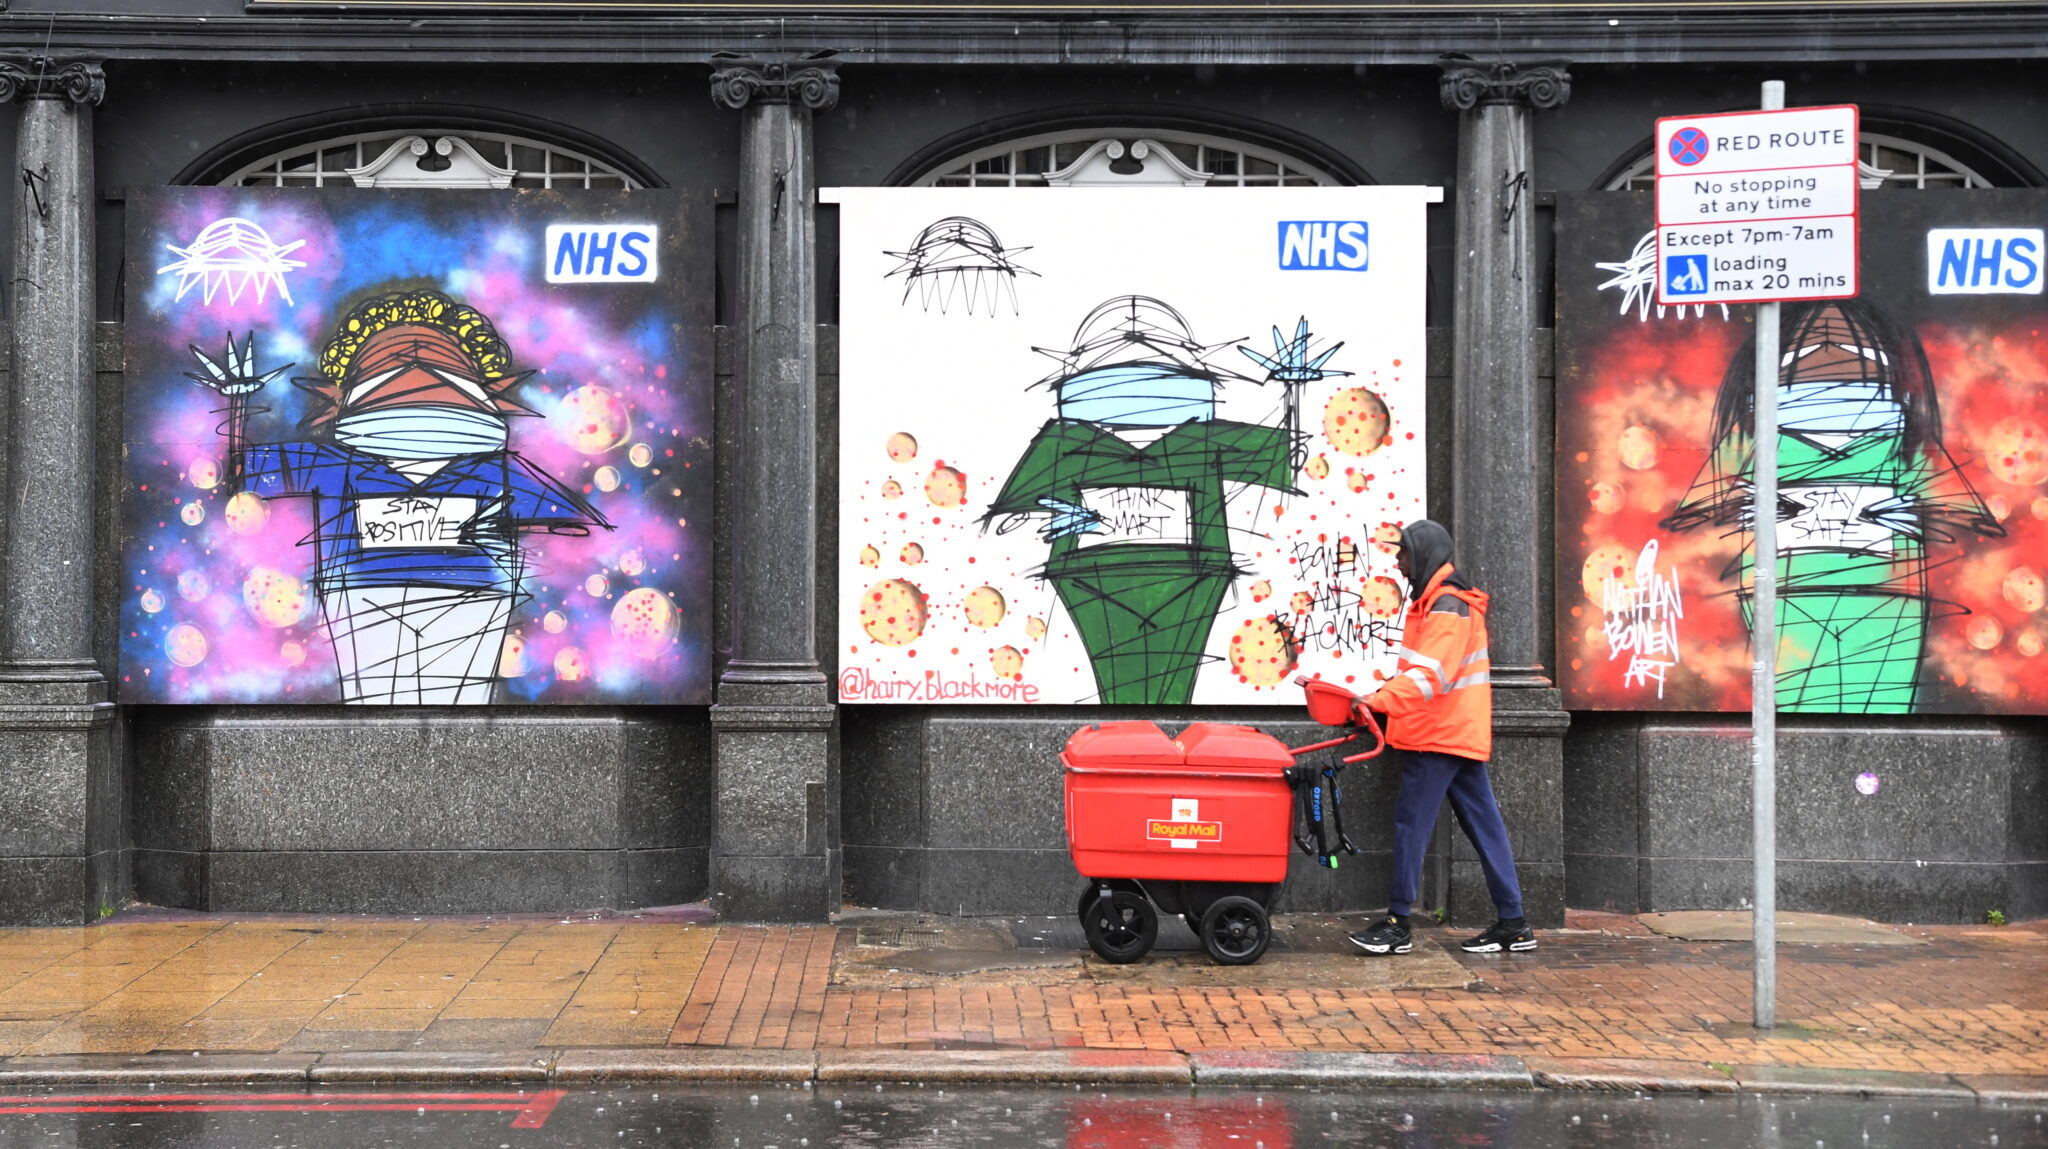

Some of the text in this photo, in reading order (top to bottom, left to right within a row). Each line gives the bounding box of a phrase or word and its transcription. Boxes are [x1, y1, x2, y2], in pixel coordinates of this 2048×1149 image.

[1717, 129, 1844, 151] RED ROUTE
[1694, 176, 1817, 194] No stopping
[1699, 196, 1812, 214] at any time
[1281, 222, 1369, 269] NHS
[1666, 226, 1833, 247] Except 7pm-7am
[553, 231, 651, 277] NHS
[1714, 256, 1787, 271] loading
[1936, 237, 2039, 288] NHS
[1714, 273, 1846, 292] max 20 mins
[382, 497, 443, 524] STAY
[1099, 487, 1175, 511] THINK
[1800, 487, 1862, 517] STAY
[364, 516, 461, 544] POSITIVE
[1100, 510, 1171, 539] SMART
[1791, 513, 1872, 547] SAFE
[1306, 579, 1363, 615] AND
[1624, 654, 1676, 700] ART
[1152, 823, 1216, 838] Royal Mail
